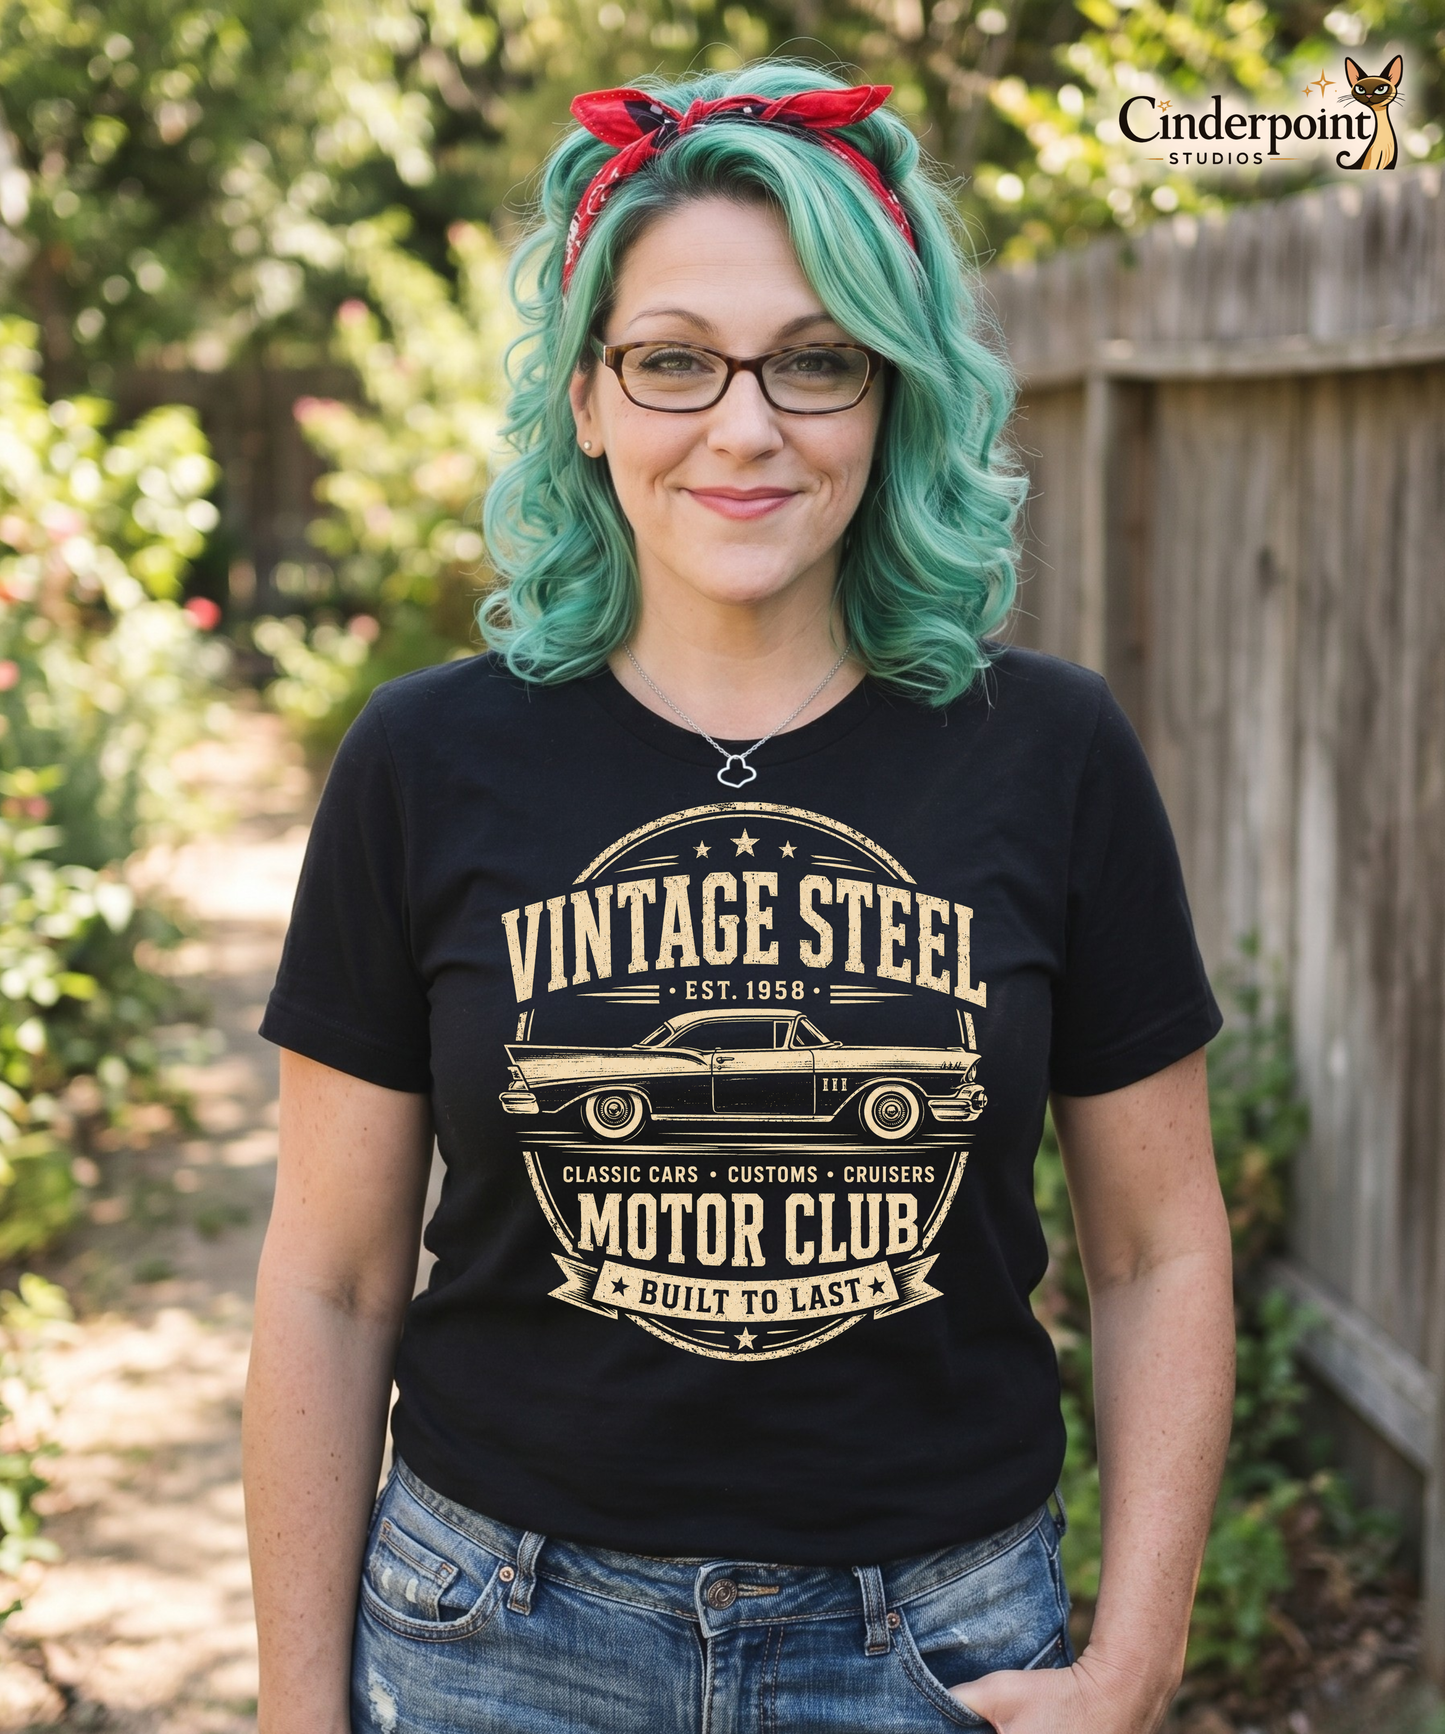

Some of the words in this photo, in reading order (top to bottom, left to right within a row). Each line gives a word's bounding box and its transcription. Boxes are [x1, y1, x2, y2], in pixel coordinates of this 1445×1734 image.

[501, 871, 778, 1003] VINTAGE
[799, 874, 987, 1008] STEEL
[685, 980, 737, 1000] EST.
[747, 980, 804, 1000] 1958
[562, 1165, 641, 1183] CLASSIC
[649, 1165, 698, 1183] CARS
[728, 1165, 818, 1183] CUSTOMS
[843, 1165, 935, 1183] CRUISERS
[577, 1193, 766, 1267] MOTOR
[785, 1193, 918, 1266] CLUB
[639, 1278, 729, 1314] BUILT
[741, 1289, 778, 1315] TO
[791, 1278, 860, 1313] LAST
